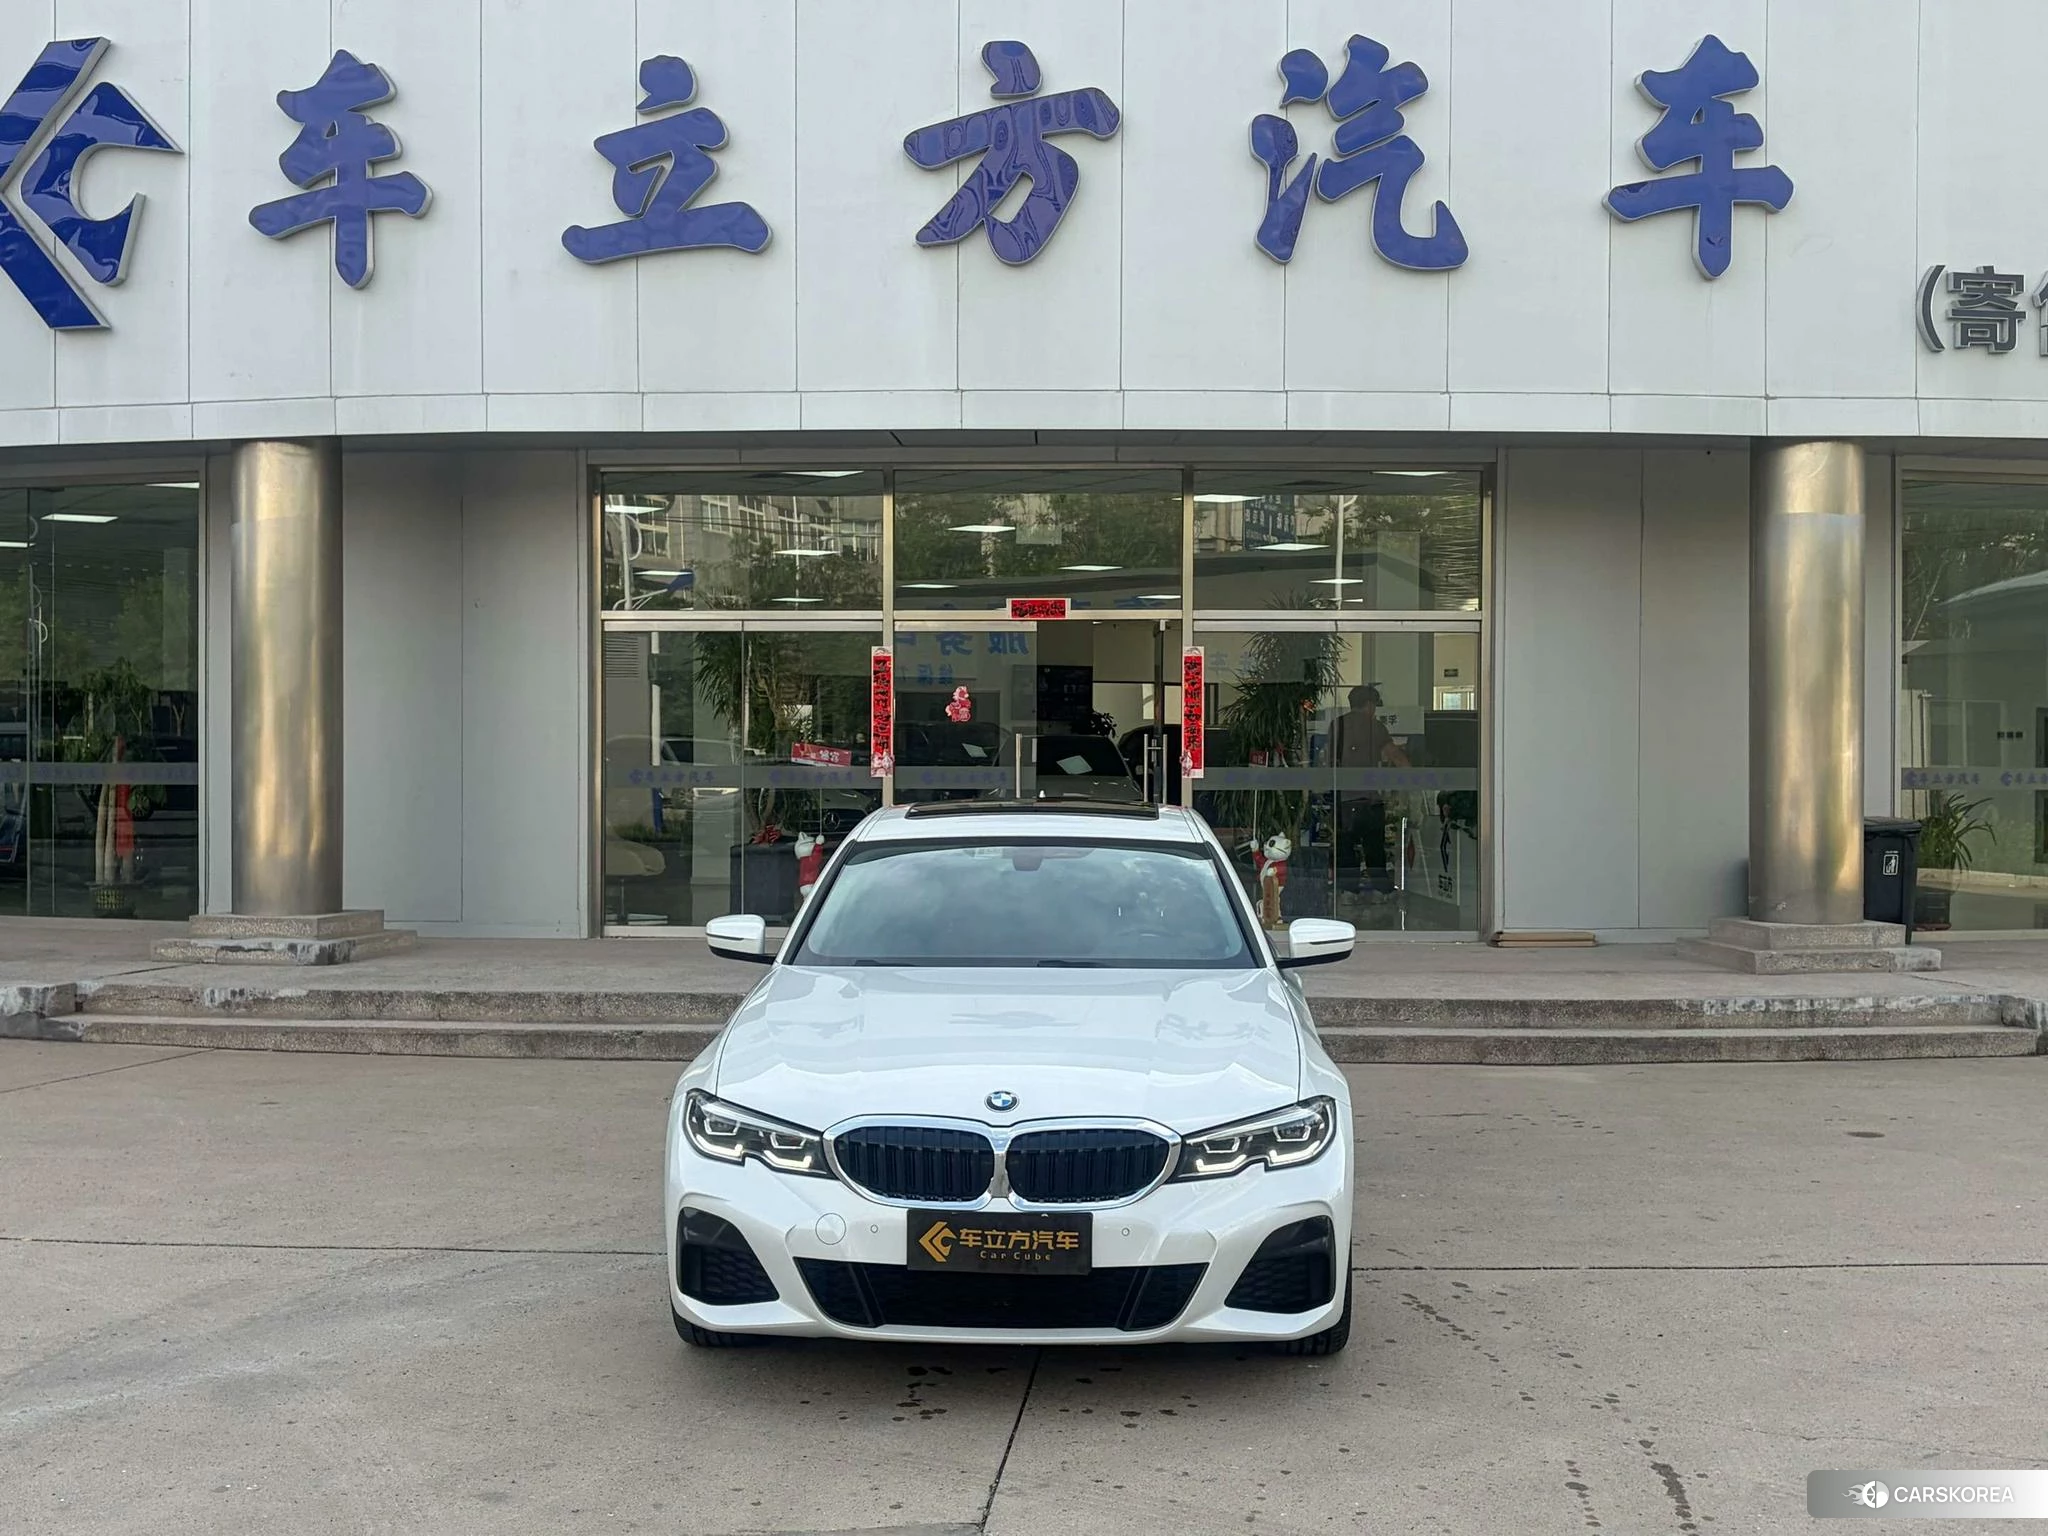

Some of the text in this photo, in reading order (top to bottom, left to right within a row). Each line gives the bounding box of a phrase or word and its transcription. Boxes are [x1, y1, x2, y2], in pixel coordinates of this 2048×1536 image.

[250, 34, 1794, 289] 车立方汽车
[959, 1228, 1079, 1250] 车立方汽车
[980, 1250, 1051, 1261] Car Cube
